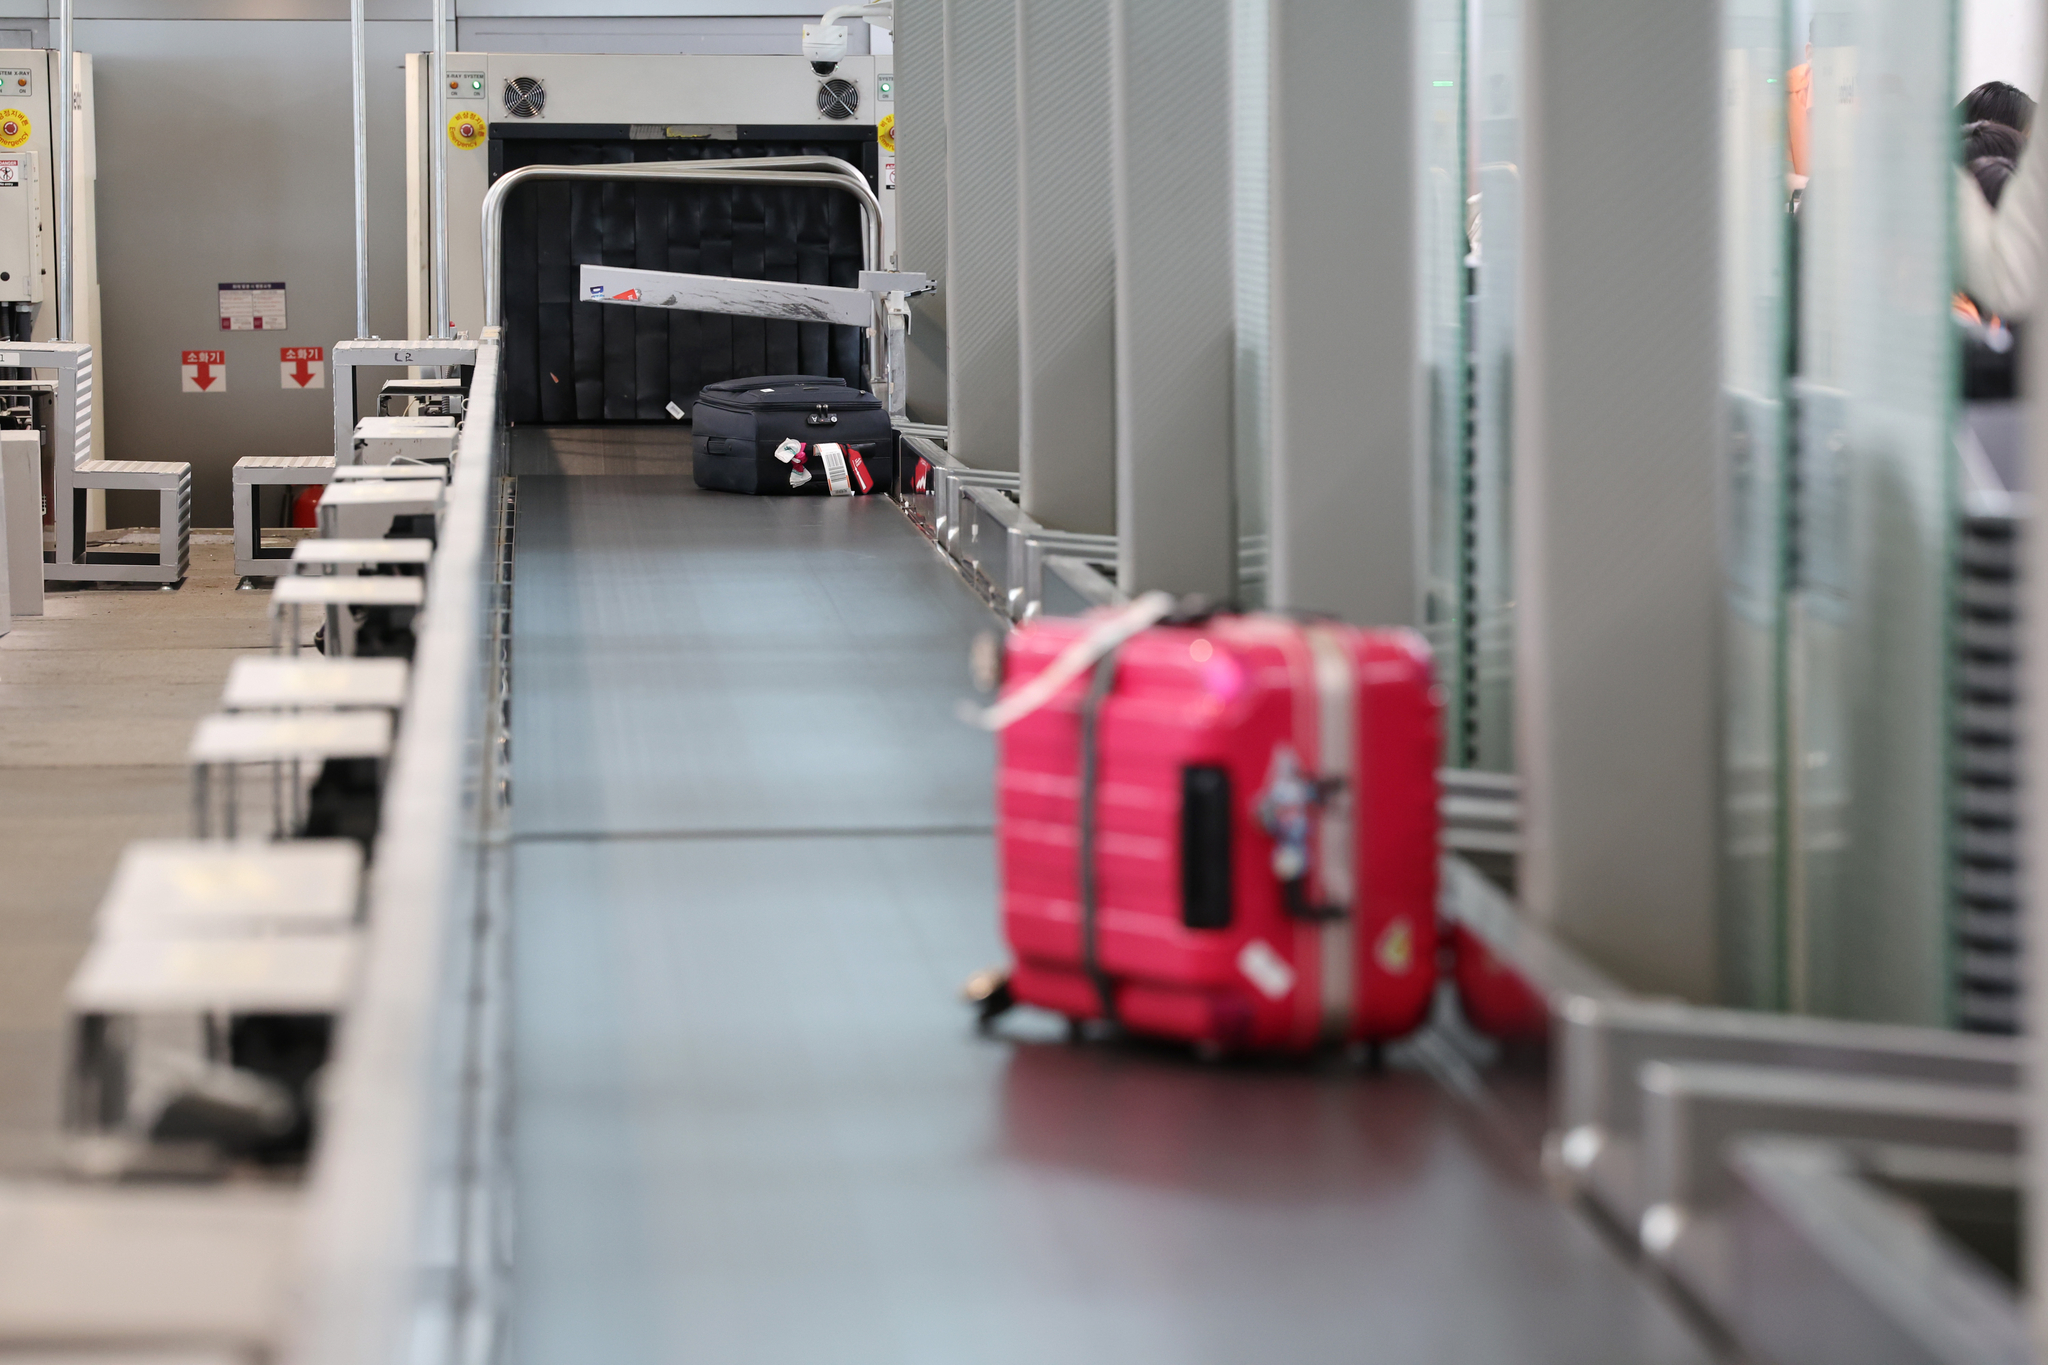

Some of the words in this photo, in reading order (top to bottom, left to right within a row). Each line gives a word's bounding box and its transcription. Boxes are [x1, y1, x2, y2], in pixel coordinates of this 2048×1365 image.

[449, 126, 478, 148] Emergency
[187, 352, 220, 363] 소화기
[286, 349, 319, 360] 소화기
